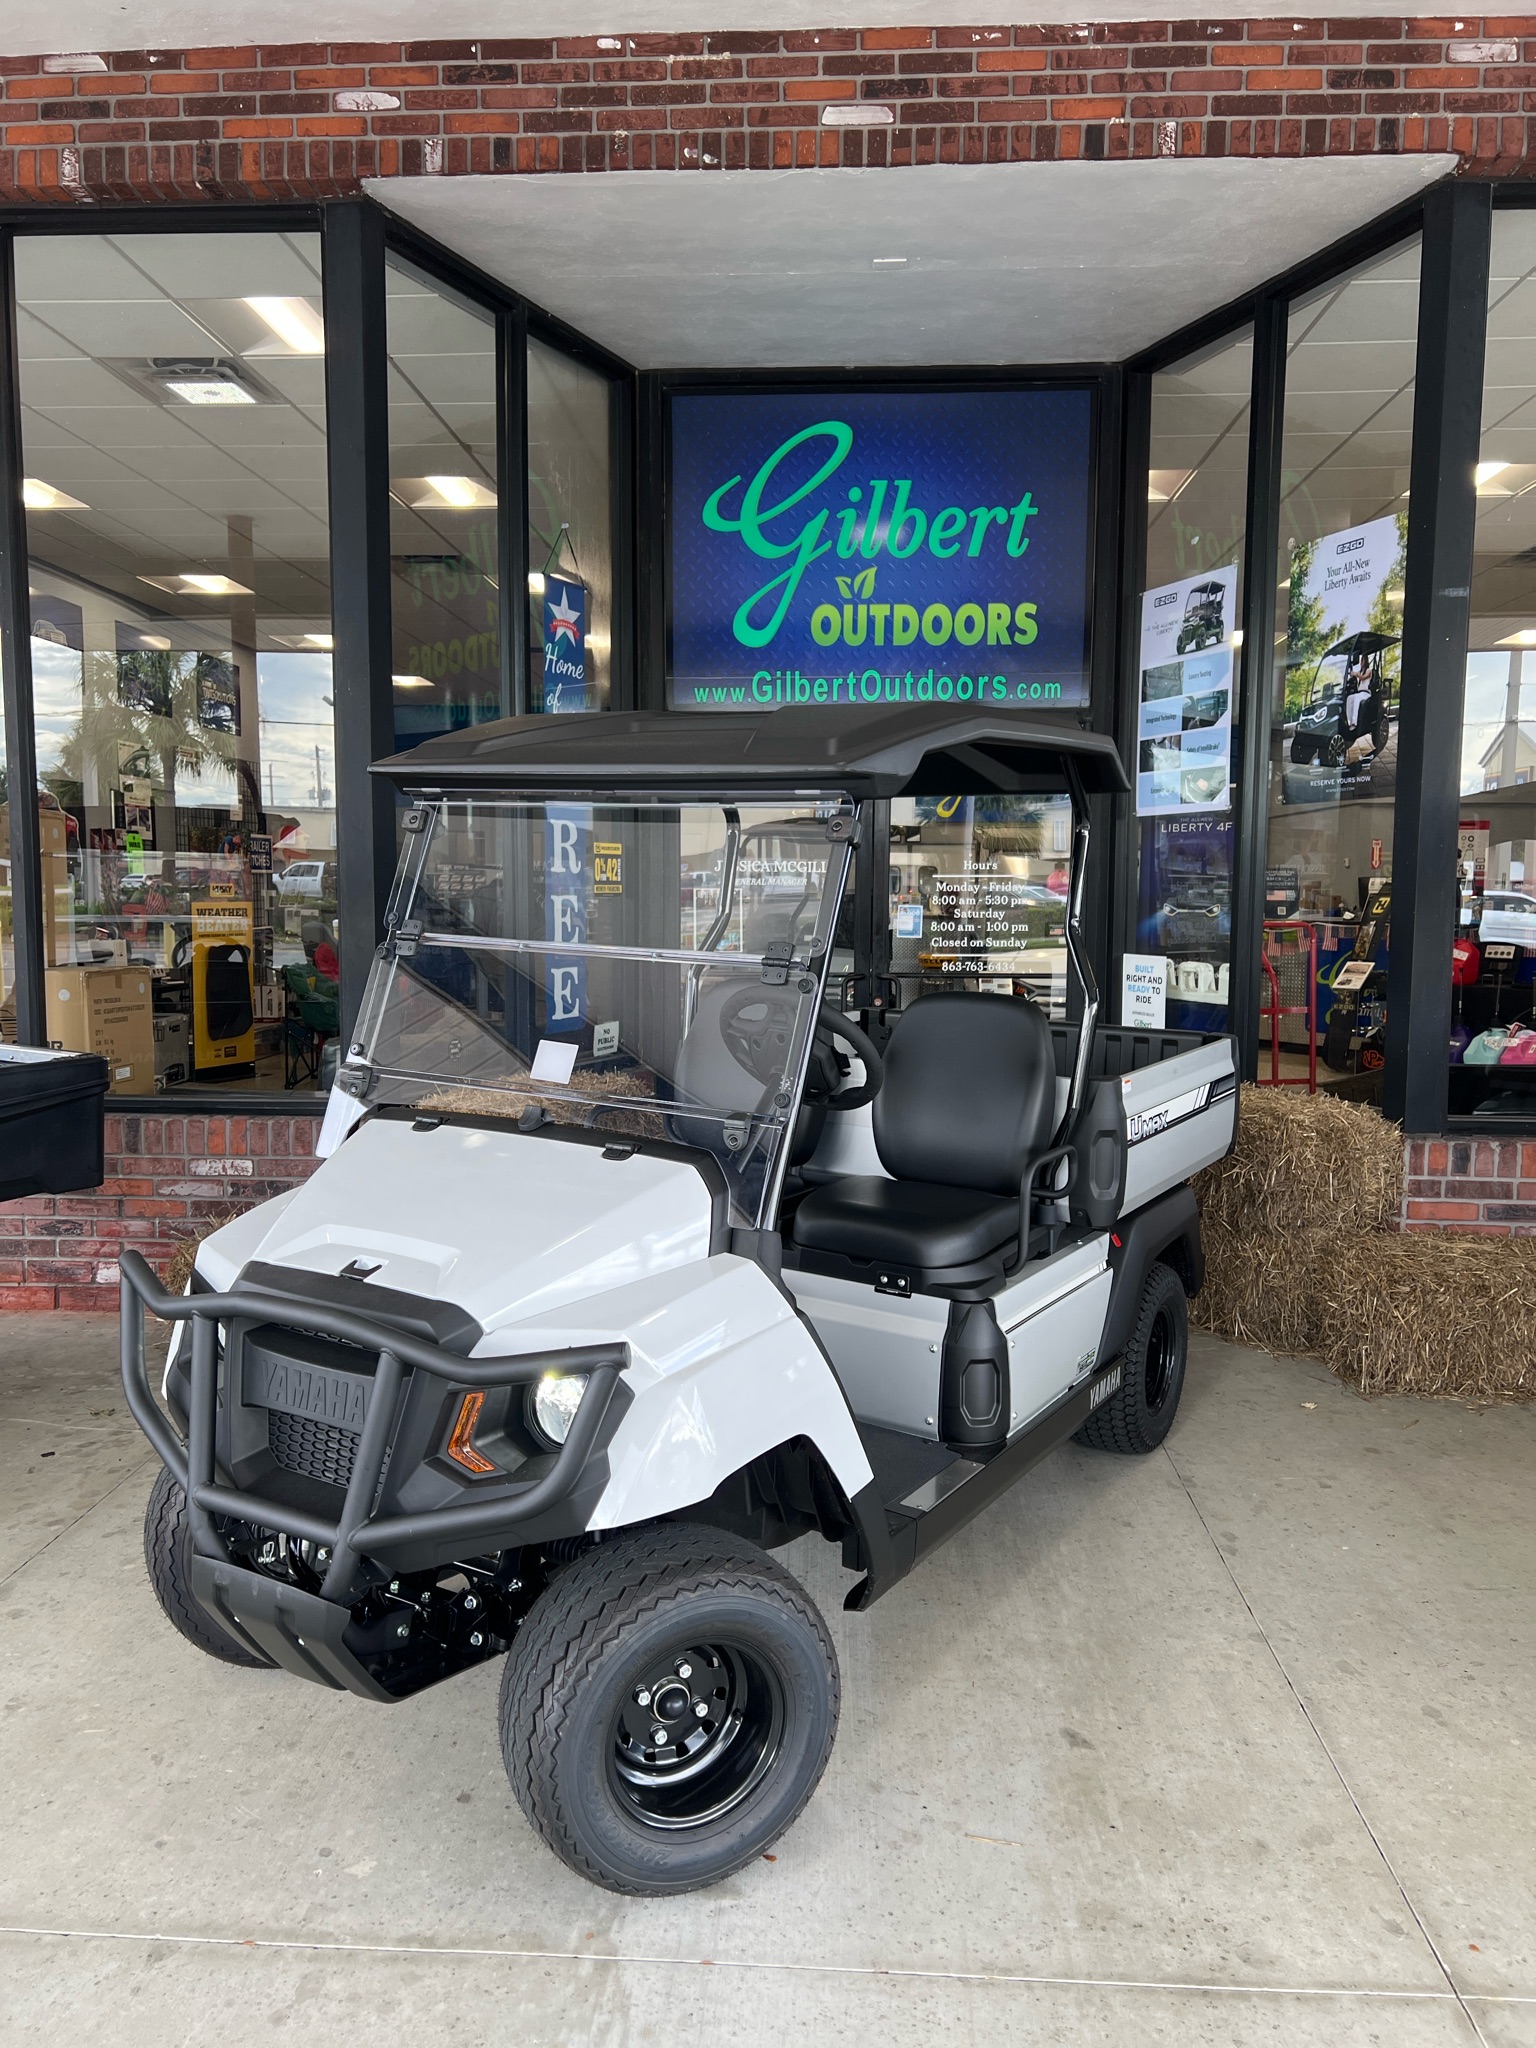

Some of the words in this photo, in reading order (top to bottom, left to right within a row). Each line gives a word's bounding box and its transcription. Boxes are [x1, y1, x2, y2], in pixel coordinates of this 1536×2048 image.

[702, 420, 1039, 648] Gilbert
[1337, 538, 1364, 555] EZGO
[1327, 567, 1341, 578] Your
[1343, 559, 1371, 574] All-New
[1324, 578, 1348, 591] Liberty
[1349, 571, 1371, 585] Awaits
[1154, 593, 1178, 608] EZGO
[810, 602, 1039, 648] OUTDOORS
[1156, 627, 1173, 636] LIBERTY
[544, 643, 585, 680] Home
[1188, 671, 1199, 681] Luxury
[1199, 669, 1212, 679] Seating
[694, 669, 1062, 703] www.GilbertOutdoors.com
[546, 683, 563, 708] of
[1160, 713, 1177, 723] Technology
[1310, 778, 1335, 787] RESERVE
[1336, 776, 1356, 785] YOURS
[1357, 775, 1371, 783] NOW
[1161, 822, 1213, 833] LIBERTY
[1216, 821, 1233, 832] 4F
[250, 840, 270, 853] RAILER
[963, 860, 998, 870] Hours
[735, 877, 765, 886] ENERAL
[767, 877, 808, 886] MANAGER
[936, 882, 980, 894] Monday
[989, 881, 1026, 894] Friday
[931, 895, 956, 905] 8:00
[958, 897, 977, 905] am
[985, 894, 1009, 905] 5:30
[1010, 897, 1028, 908] pm
[196, 908, 248, 918] WEATHER
[953, 908, 1006, 920] Saturday
[196, 918, 249, 932] BEATER
[930, 921, 956, 932] 8:00
[957, 924, 976, 932] am
[986, 921, 1009, 932] 1:00
[1010, 924, 1029, 935] pm
[931, 937, 968, 948] Closed
[968, 940, 984, 948] on
[985, 937, 1028, 950] Sunday
[941, 961, 1017, 972] 863-763-6434
[1135, 964, 1154, 974] BUILT
[1126, 974, 1146, 983] RIGHT
[1147, 976, 1163, 985] AND
[1127, 984, 1151, 994] READY
[1151, 986, 1161, 995] TO
[1135, 995, 1152, 1004] RIDE
[1133, 1019, 1152, 1029] Gilbert
[597, 1036, 615, 1046] PUBLIC
[1130, 1109, 1169, 1142] UMAX
[261, 1359, 366, 1426] YAMAHA
[1089, 1365, 1121, 1411] YAMAHA
